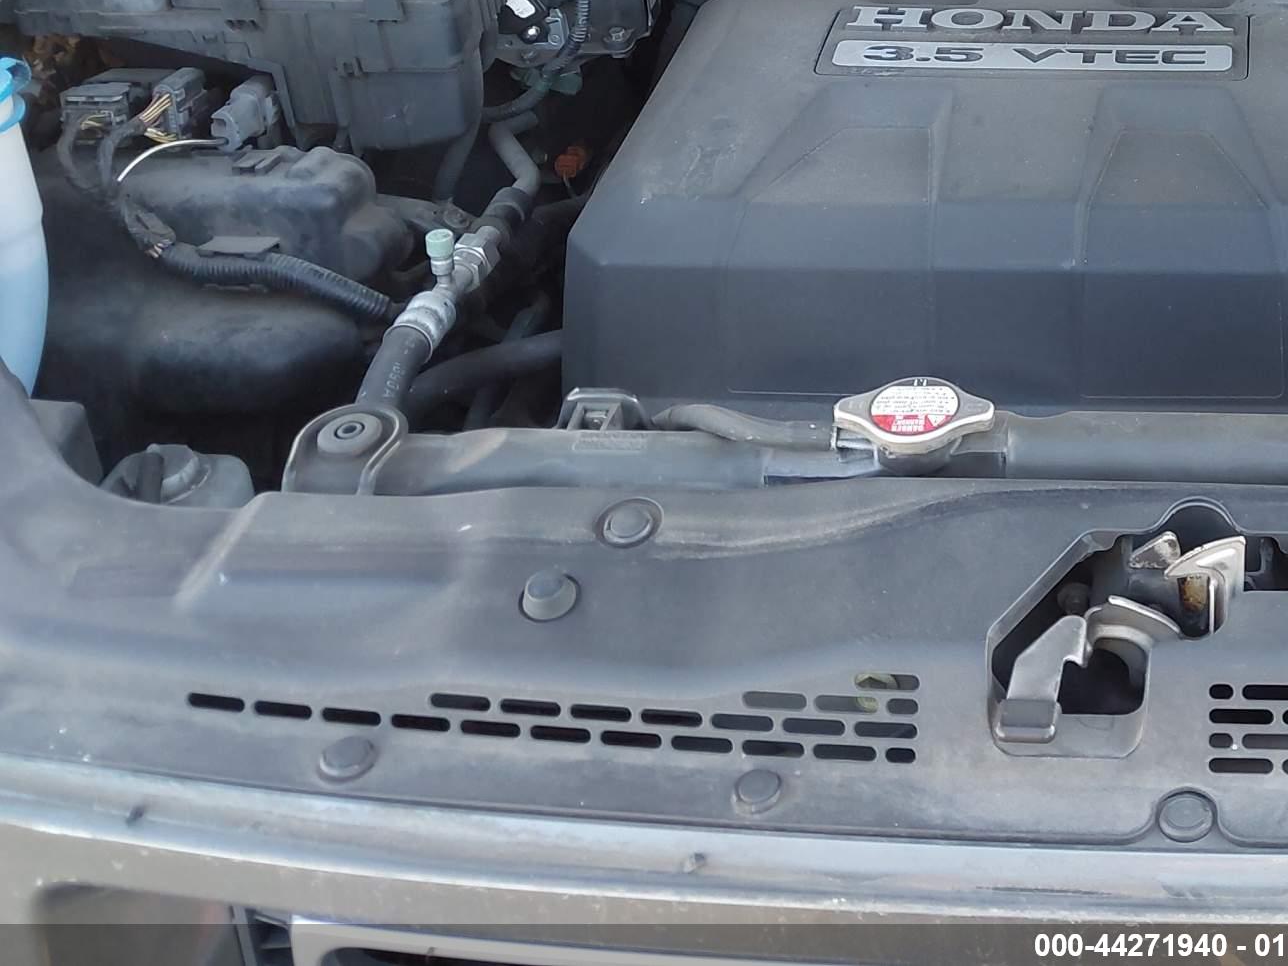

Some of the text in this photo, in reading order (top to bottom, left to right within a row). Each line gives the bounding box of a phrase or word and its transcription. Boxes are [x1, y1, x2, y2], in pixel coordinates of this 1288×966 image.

[846, 5, 1233, 33] HONDA
[863, 44, 1206, 65] 3.5 VTEC
